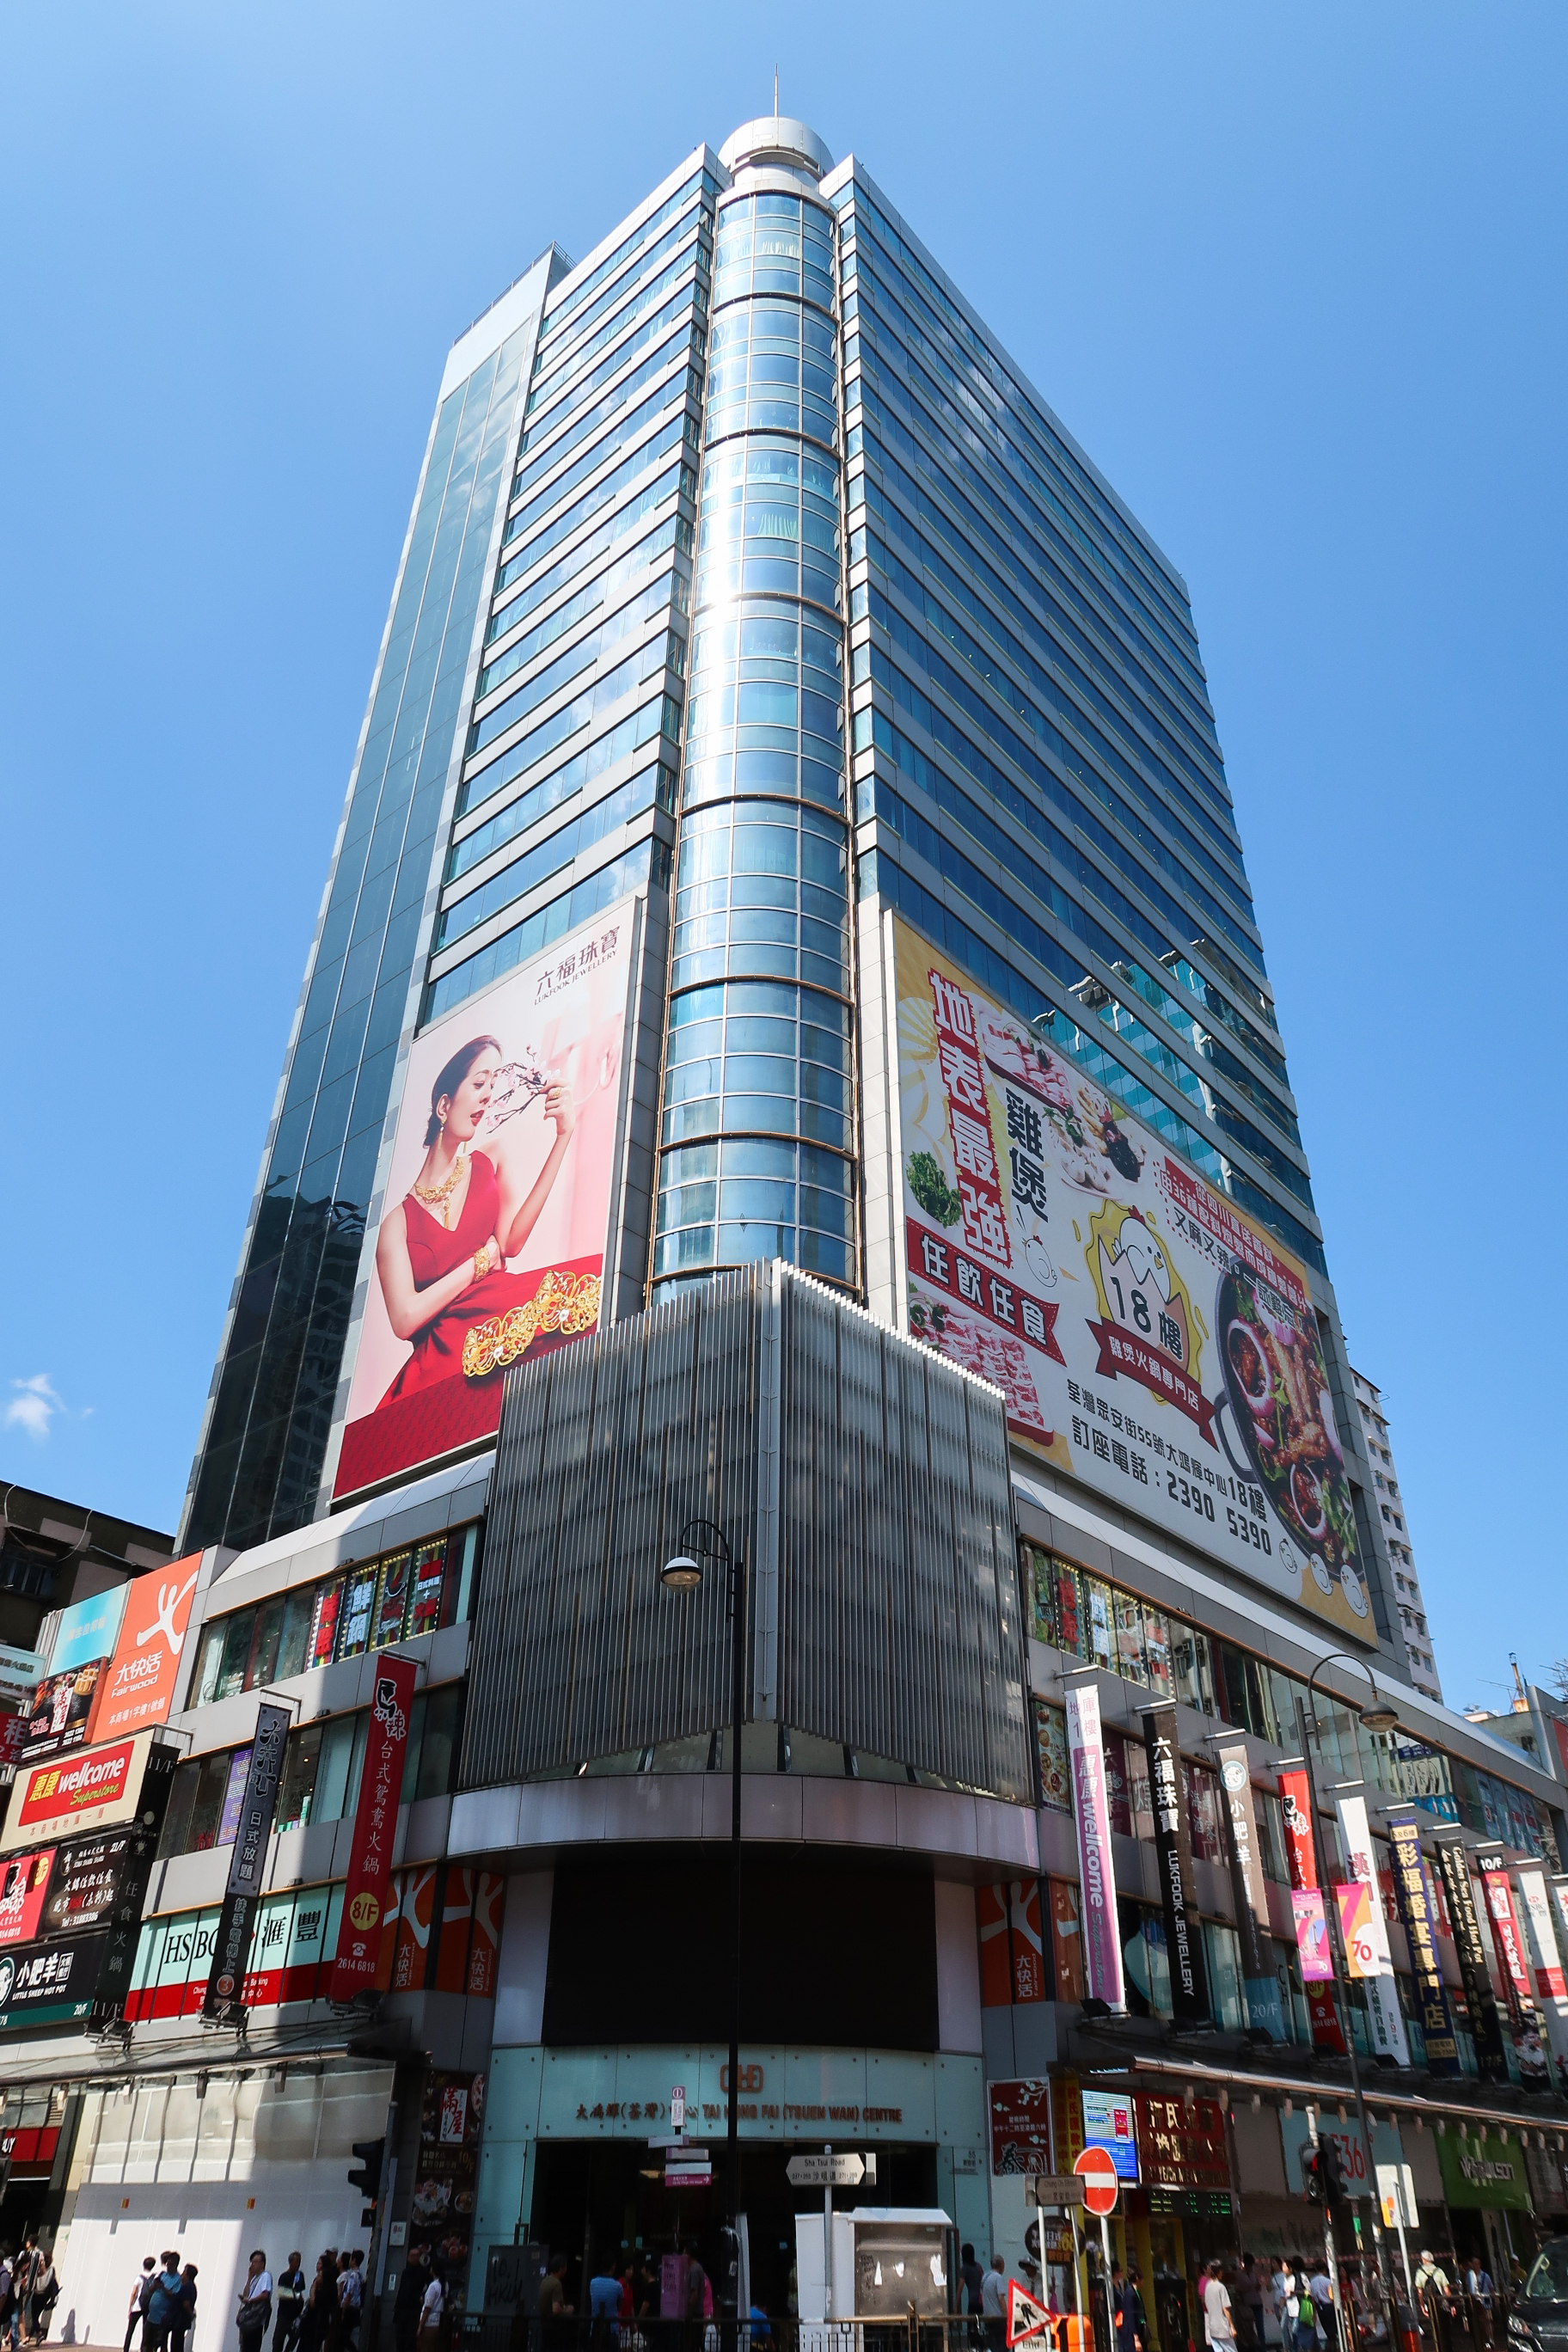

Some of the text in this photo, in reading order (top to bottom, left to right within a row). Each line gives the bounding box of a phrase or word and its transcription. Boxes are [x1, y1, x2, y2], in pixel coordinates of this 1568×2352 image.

[534, 948, 617, 1006] LUKFOOK JEWELLERY
[536, 926, 620, 997] 六福珠寶
[930, 971, 1009, 1263] 地表最強
[1006, 1087, 1049, 1223] 雞煲
[921, 1234, 1046, 1345] 任飲任食
[1110, 1276, 1183, 1362] 18樓
[1108, 1335, 1199, 1412] 雞煲火鍋專門店
[1167, 1471, 1216, 1523] 2390
[1227, 1509, 1272, 1557] 5390
[346, 1581, 372, 1646] 鮮鍋
[111, 1675, 158, 1700] Fairwood
[113, 1650, 163, 1687] 大快活
[1069, 1697, 1096, 1715] 地庫
[28, 1756, 126, 1803] 惠康 wellcome
[70, 1782, 119, 1806] Superstore
[1079, 1755, 1098, 1800] 惠康
[362, 1740, 393, 1876] 台式鴛鴦火鍋
[239, 1810, 262, 1880] 日式放題
[1230, 1799, 1252, 1866] 小肥羊
[1082, 1801, 1104, 1908] wellcome
[1152, 1736, 1195, 1996] 六福珠寶 LUKFOOK JEWELLERY
[1453, 1847, 1465, 1879] Golden
[1480, 1857, 1503, 1871] 10/F
[352, 1901, 379, 1922] 8/F
[1461, 1881, 1469, 1900] Sea
[1464, 1900, 1476, 1924] Food
[1351, 1940, 1372, 1962] 70
[1396, 1841, 1447, 2030] 彩福婚宴專門店
[1469, 1924, 1480, 1946] Hot
[1473, 1946, 1483, 1964] Pot
[15, 1951, 58, 1988] 小肥羊
[337, 1957, 376, 1973] 2614 6818
[395, 1944, 412, 1988] 大快活
[469, 1948, 487, 1991] 大快活
[1016, 1955, 1032, 1998] 大快活
[1318, 1961, 1328, 1972] 70
[12, 1984, 67, 2001] LITTLE SHEEP HOT POT
[1251, 2002, 1278, 2018] 20/F
[441, 2086, 463, 2135] 滿屋
[702, 2104, 720, 2120] TAI
[724, 2104, 757, 2120] HNG
[762, 2104, 780, 2120] FAI
[783, 2103, 825, 2121] (TSUEN
[829, 2104, 859, 2122] WAN)
[863, 2107, 902, 2123] CENTRE
[805, 2159, 815, 2167] Sha
